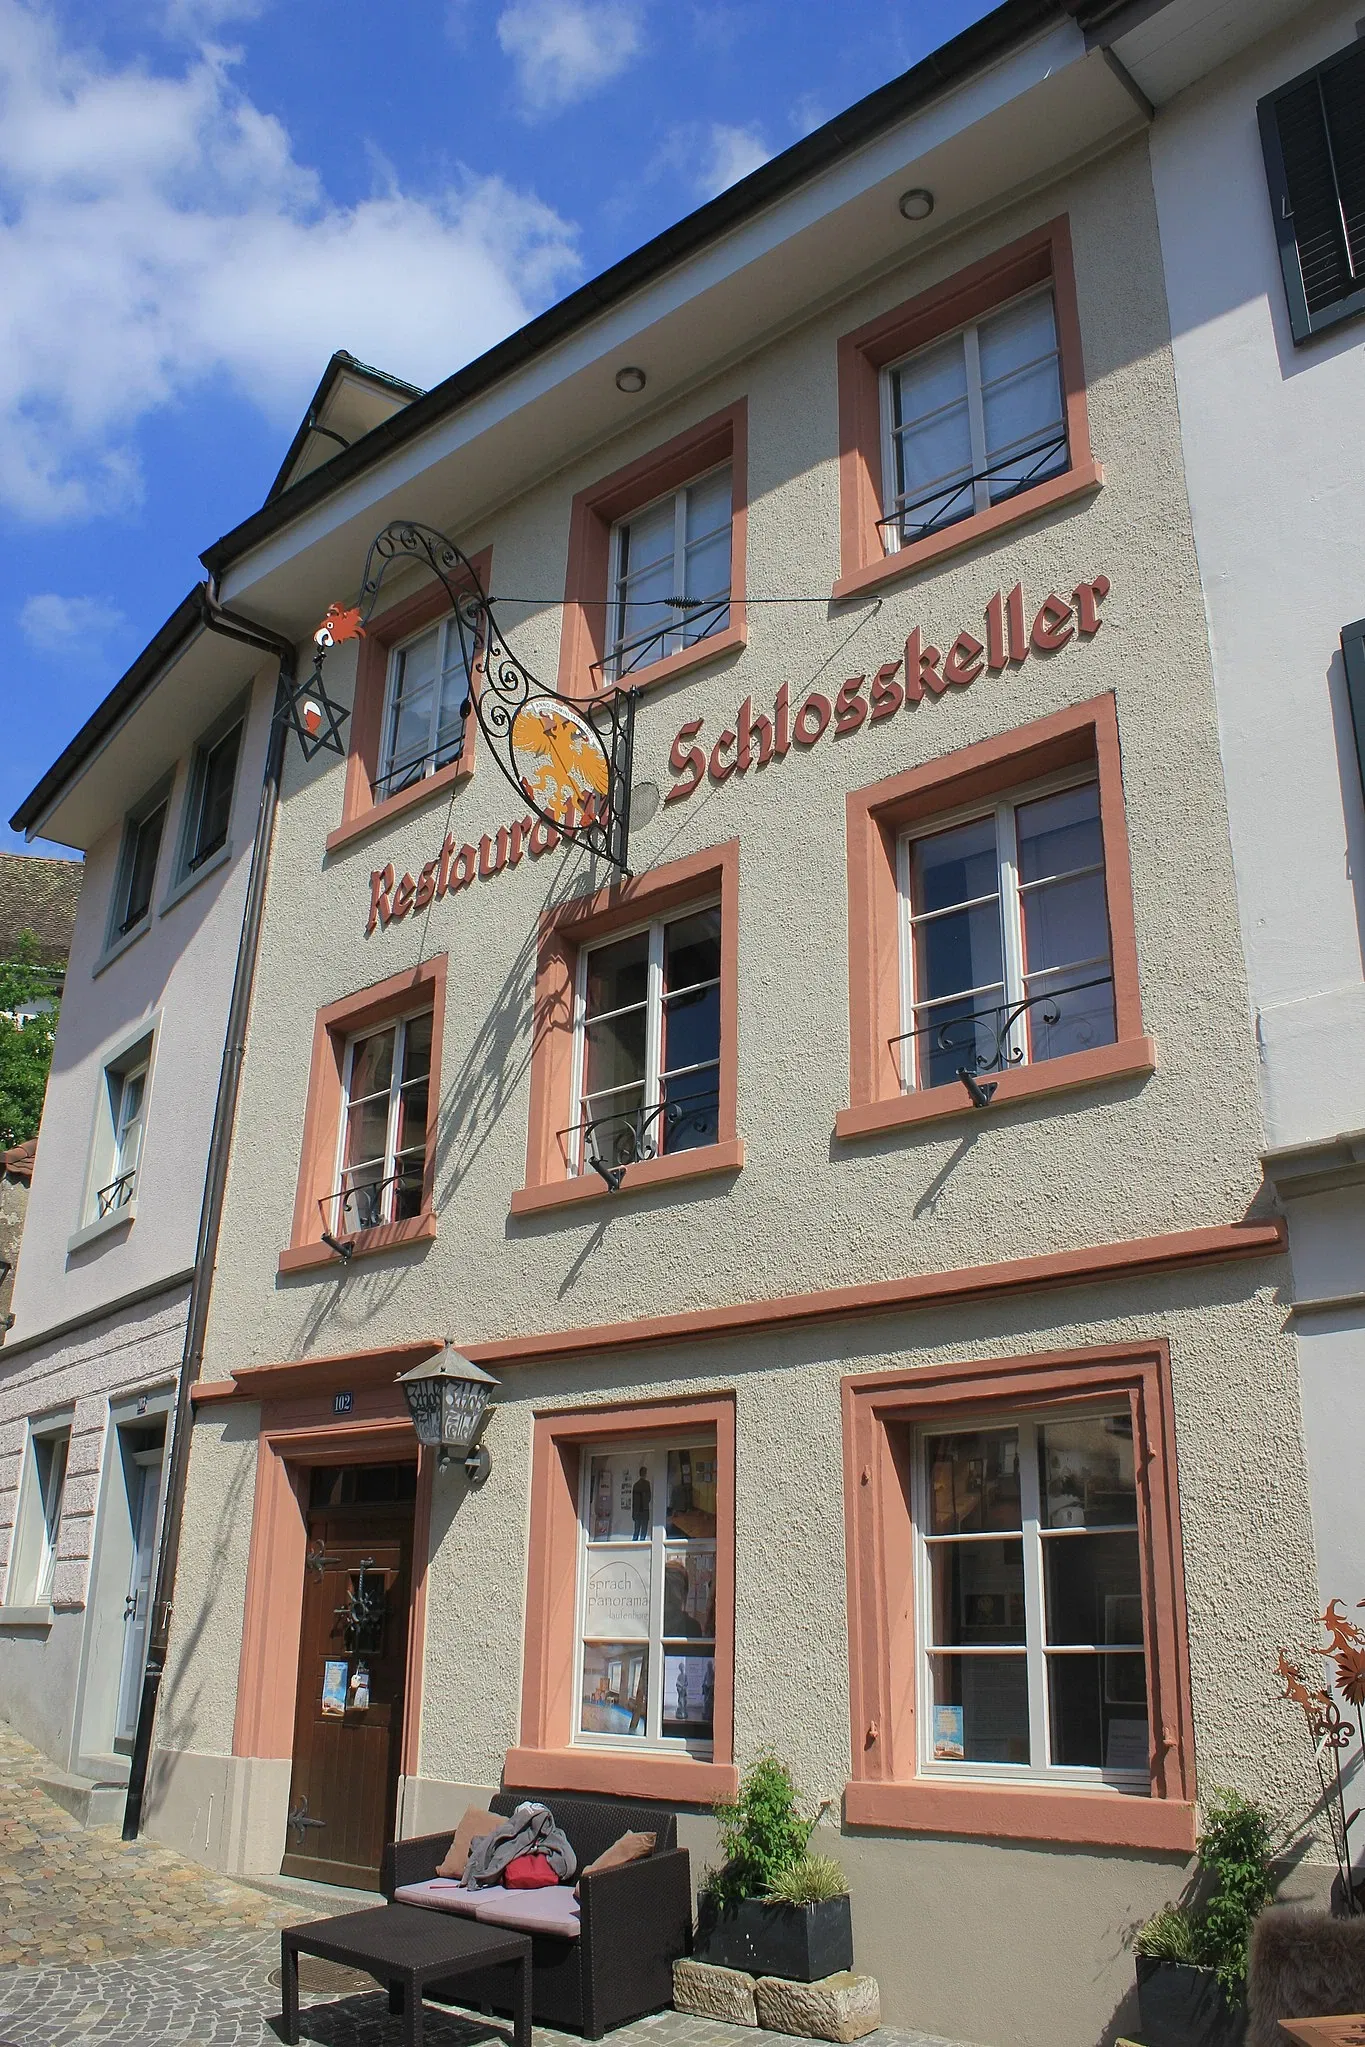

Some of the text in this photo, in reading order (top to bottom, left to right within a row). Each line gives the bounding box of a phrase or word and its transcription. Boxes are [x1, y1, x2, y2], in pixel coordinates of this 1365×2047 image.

[665, 574, 1111, 803] Schlosskeller
[335, 1395, 350, 1411] 102
[589, 1572, 632, 1597] sprach
[588, 1596, 649, 1615] panorama
